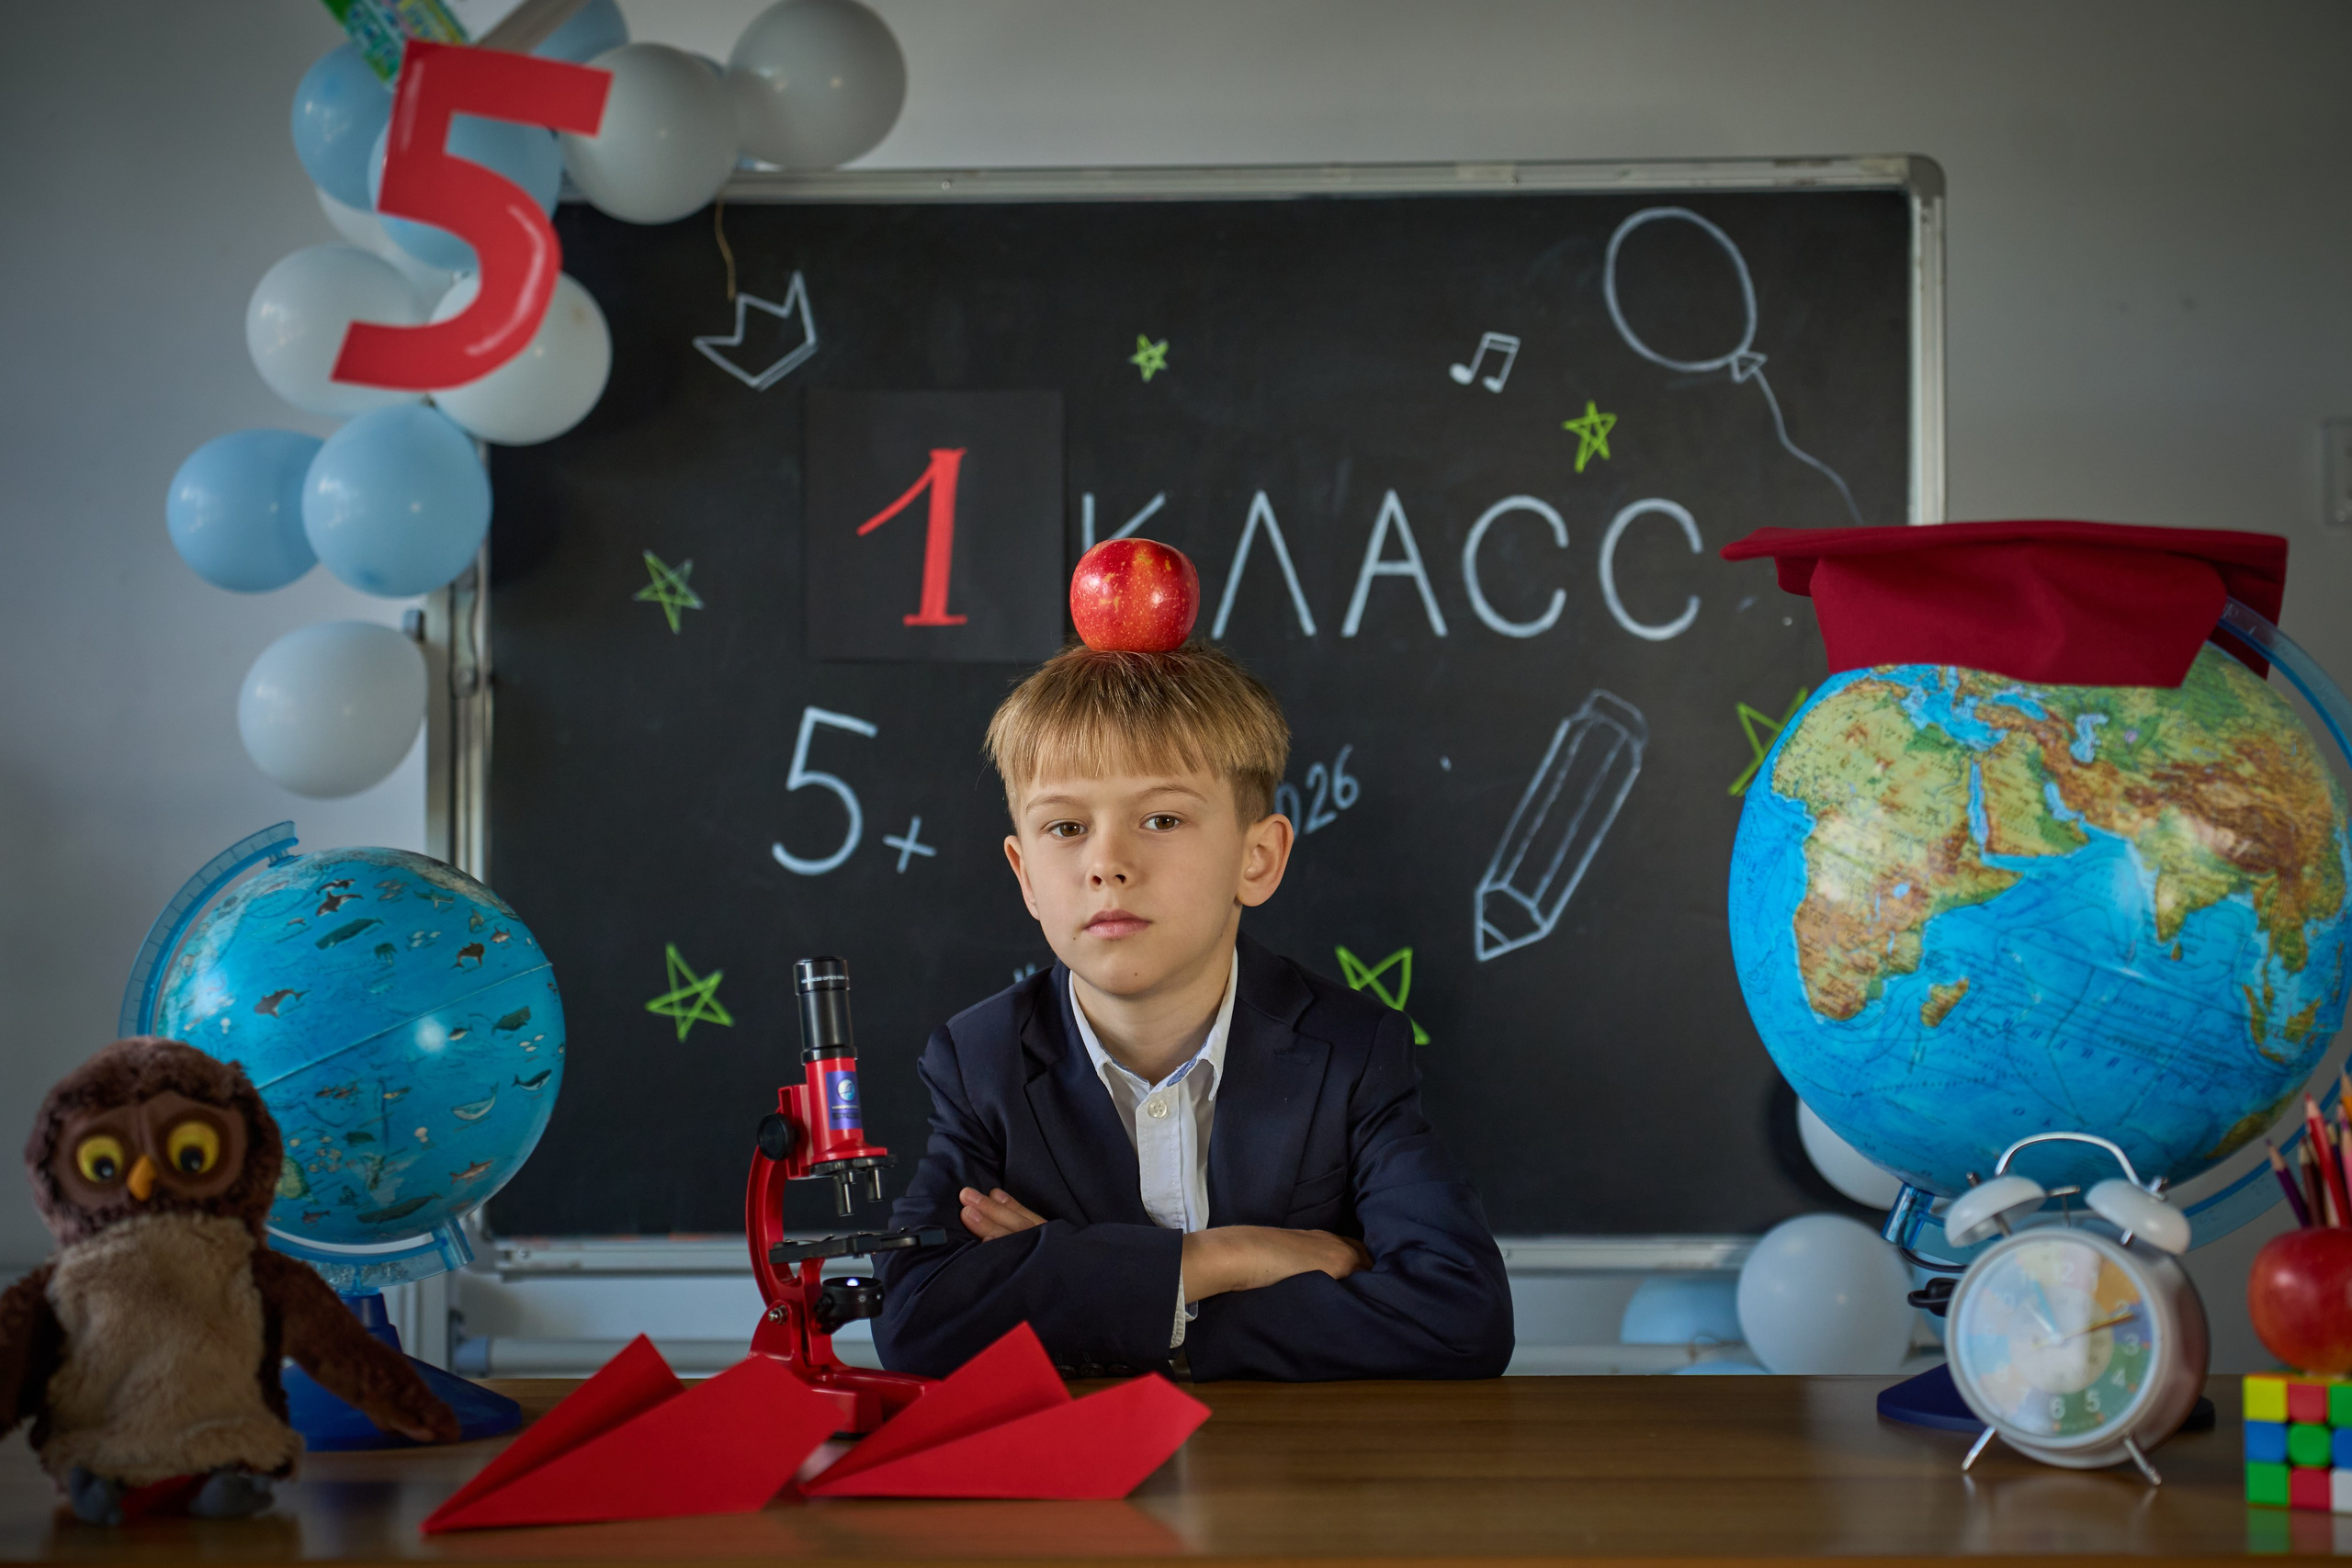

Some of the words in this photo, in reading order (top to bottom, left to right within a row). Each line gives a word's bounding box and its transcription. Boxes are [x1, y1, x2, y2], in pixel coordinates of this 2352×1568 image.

[330, 39, 614, 392] 5
[857, 447, 967, 626] 1
[2123, 1333, 2140, 1356] 3
[2110, 1366, 2126, 1388] 4
[2050, 1396, 2066, 1419] 6
[2086, 1389, 2101, 1413] 5
